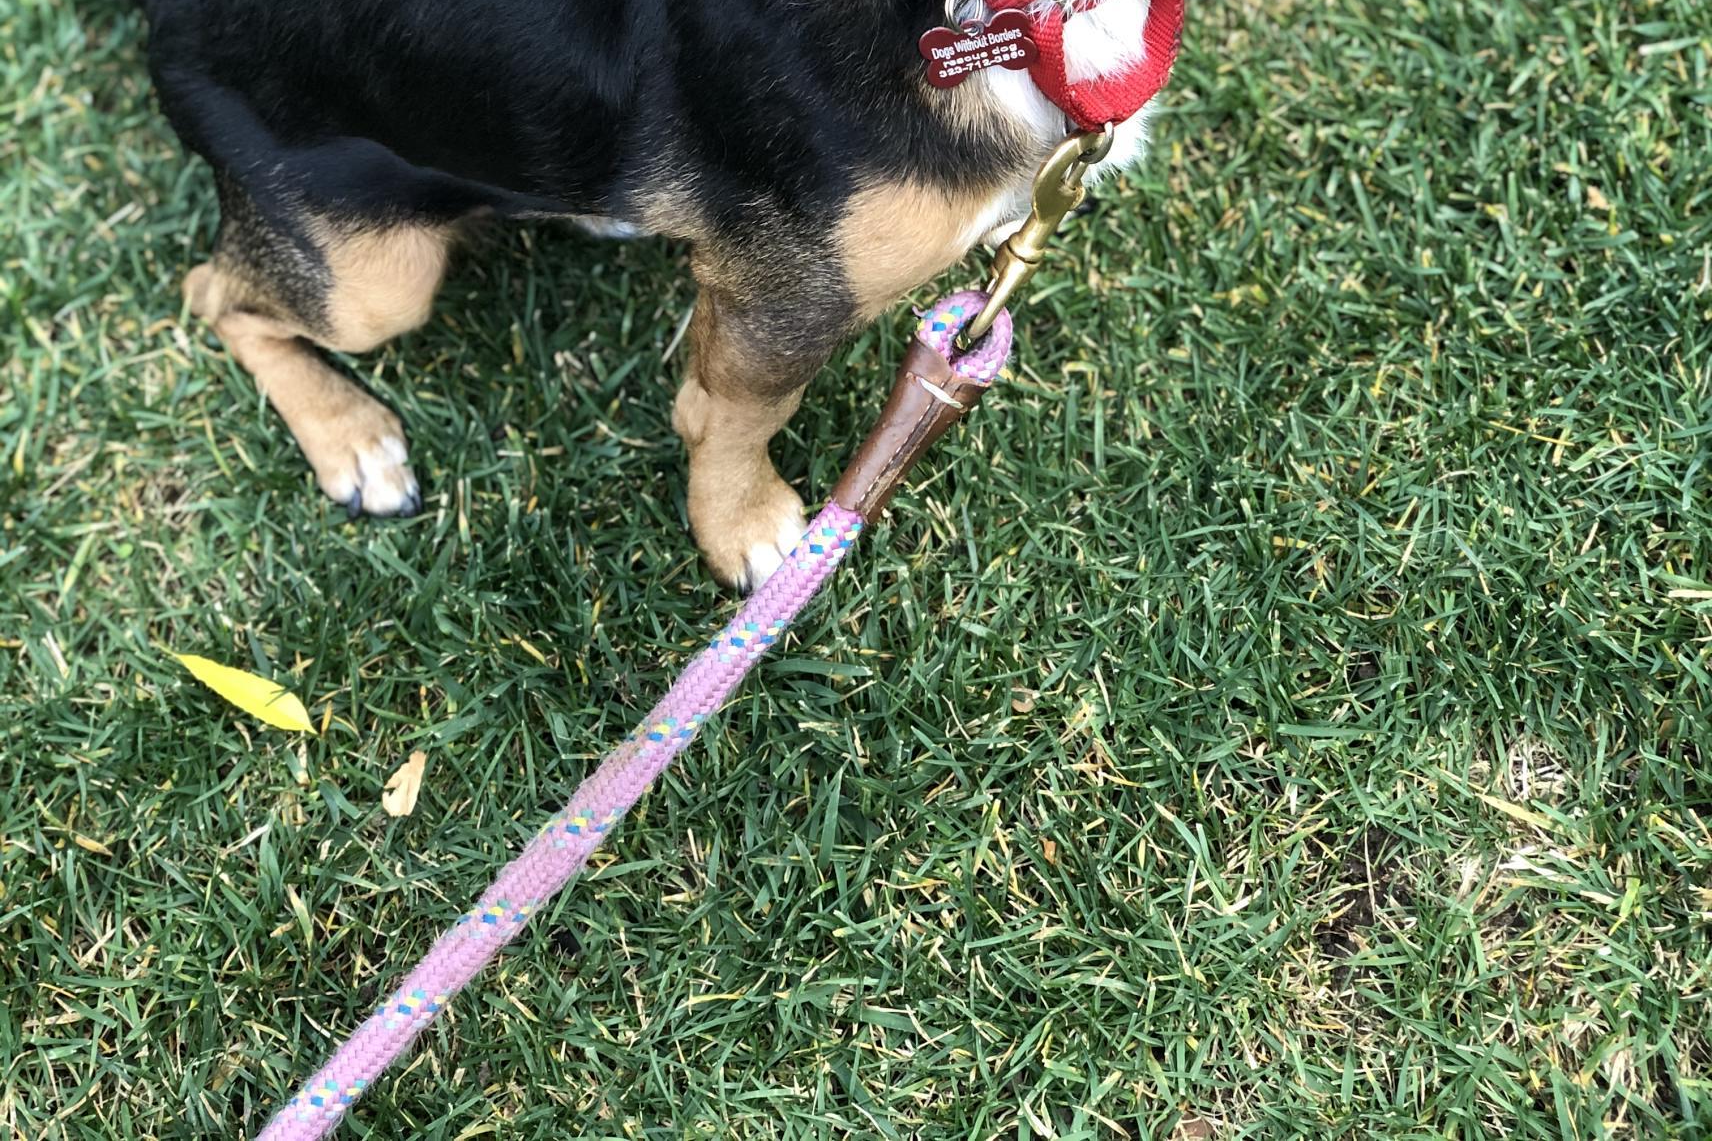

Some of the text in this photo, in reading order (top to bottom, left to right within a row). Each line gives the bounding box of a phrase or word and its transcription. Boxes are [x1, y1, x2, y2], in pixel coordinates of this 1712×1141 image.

[931, 28, 1022, 59] Dogs Without Borders
[943, 43, 1018, 68] rescue dog
